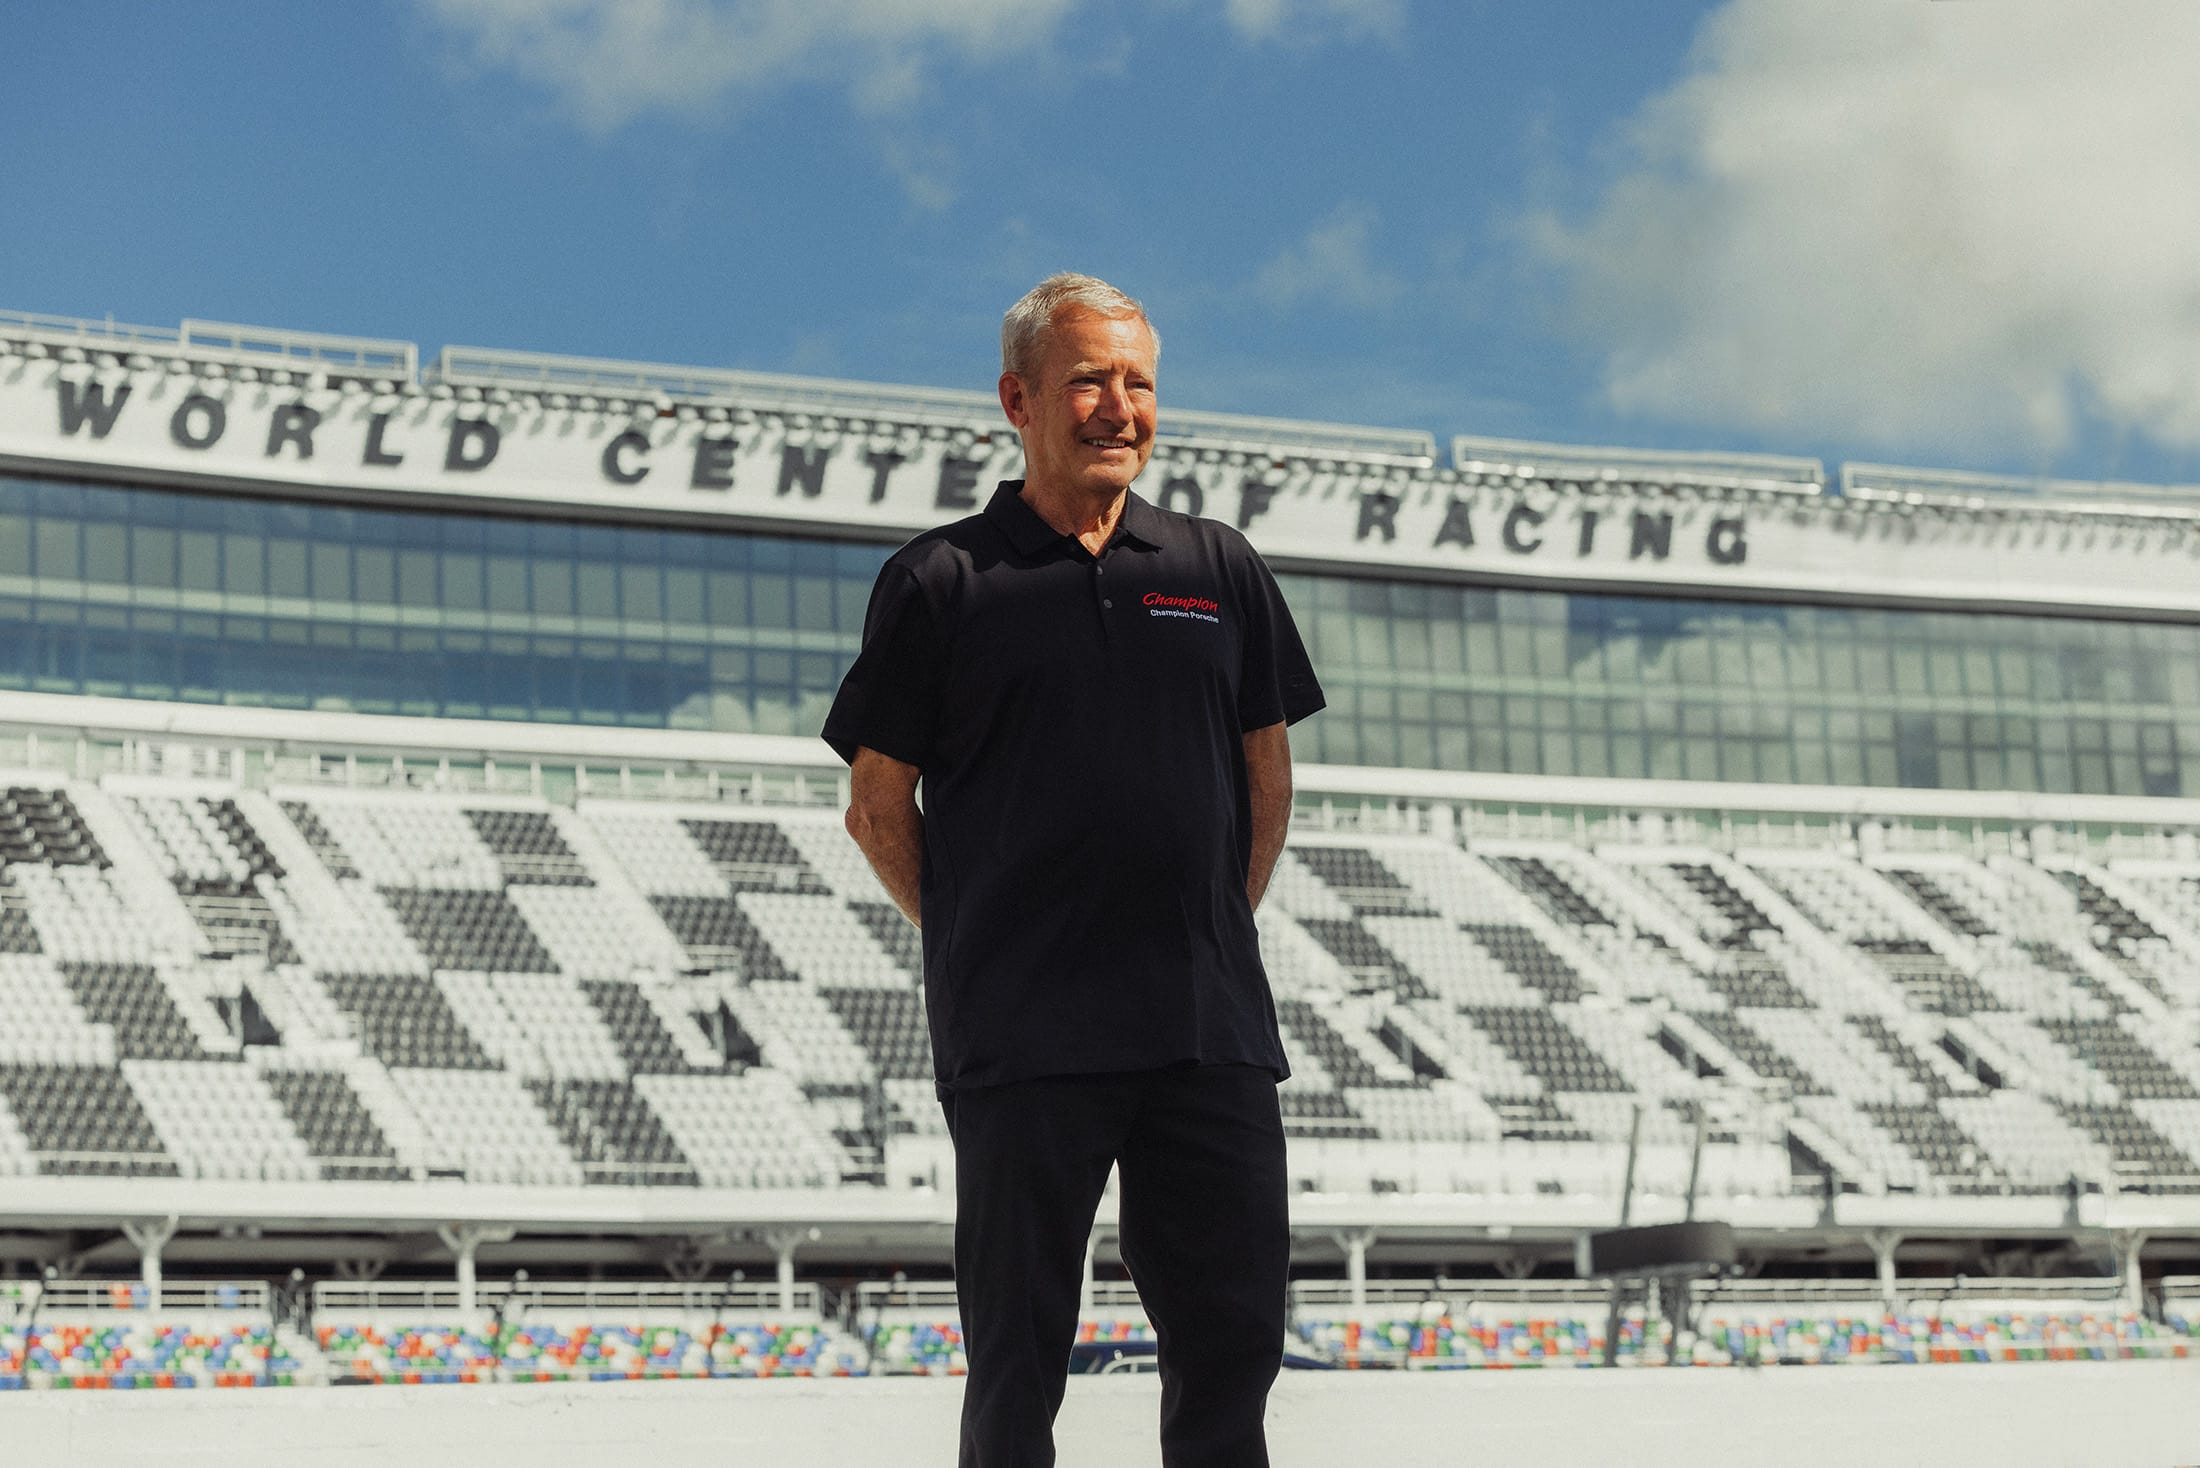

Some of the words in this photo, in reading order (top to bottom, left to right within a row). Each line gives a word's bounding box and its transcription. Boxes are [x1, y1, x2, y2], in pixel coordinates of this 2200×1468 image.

[58, 378, 501, 472] WORLD
[602, 430, 1010, 511] CENTE
[1158, 476, 1279, 530] OF
[1356, 494, 1748, 565] RACING
[1142, 592, 1218, 612] Champion
[1150, 609, 1190, 618] Champion
[1190, 611, 1219, 623] Porsche
